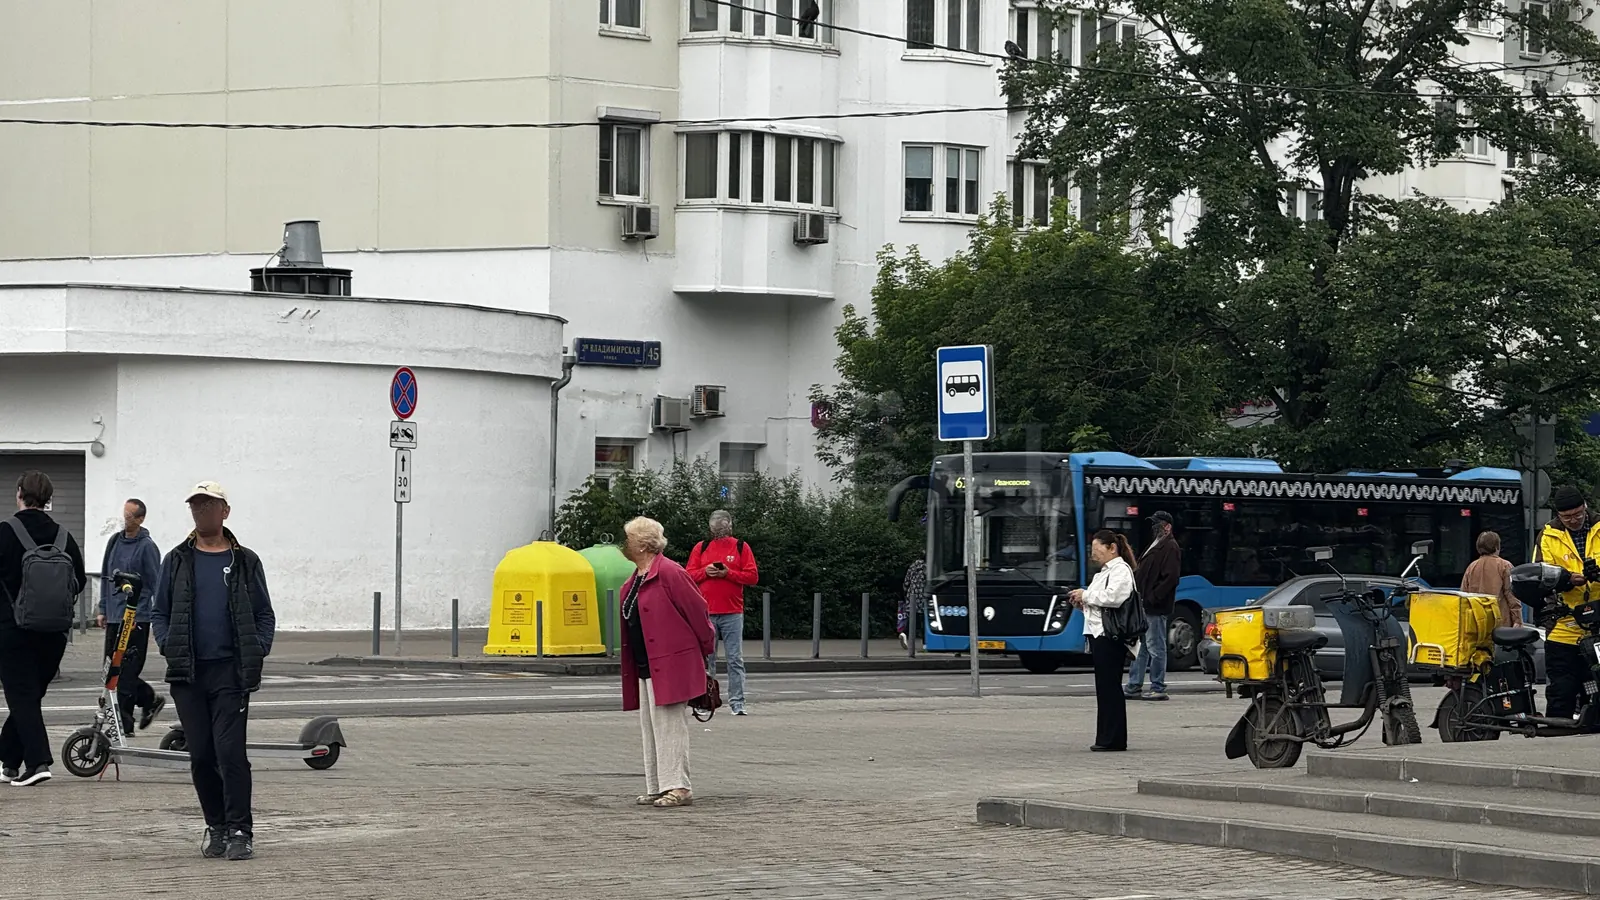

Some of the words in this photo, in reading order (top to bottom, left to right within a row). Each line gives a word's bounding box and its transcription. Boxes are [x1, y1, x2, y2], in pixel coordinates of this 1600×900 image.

[590, 344, 640, 354] ВЛАДИМИРСКАЯ
[648, 348, 660, 360] 45
[398, 476, 408, 487] 30
[118, 611, 136, 648] WHOOSH
